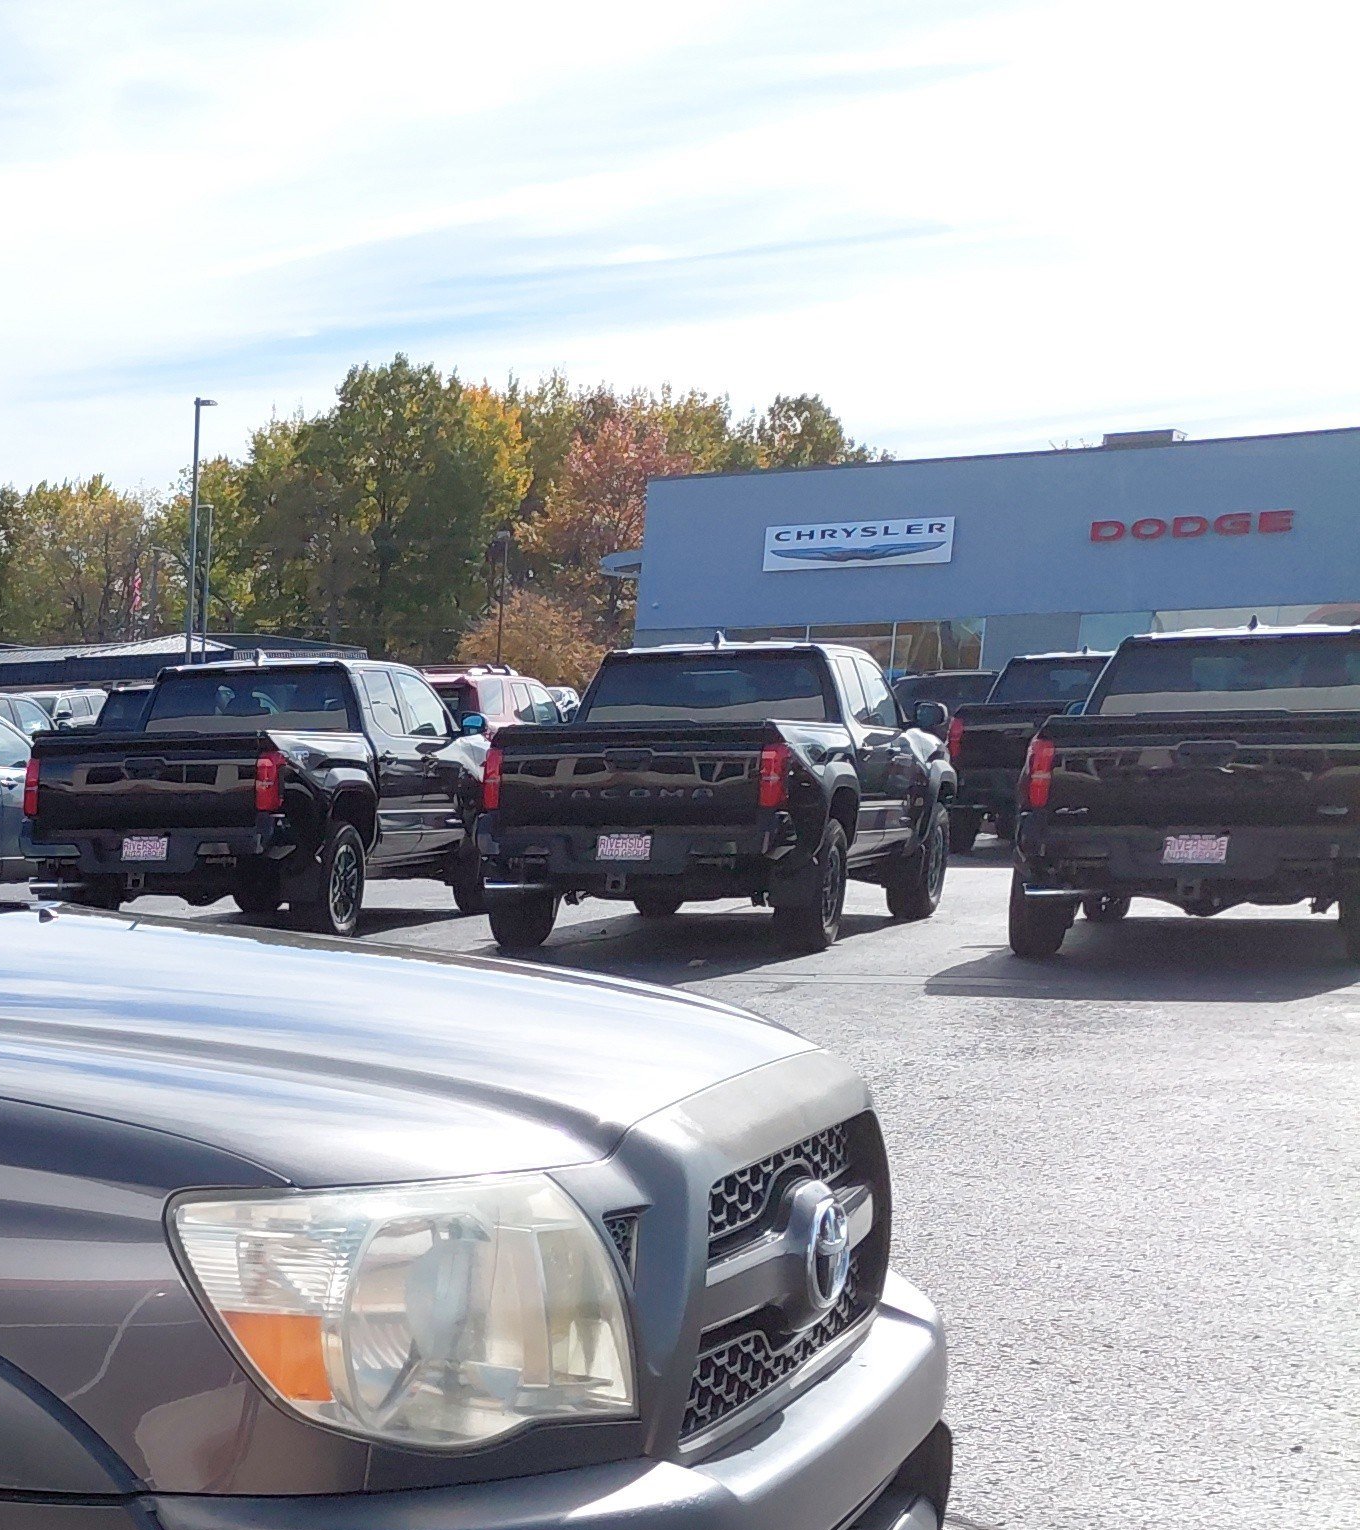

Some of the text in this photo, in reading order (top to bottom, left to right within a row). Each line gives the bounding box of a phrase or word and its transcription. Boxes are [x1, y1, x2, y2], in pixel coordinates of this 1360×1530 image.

[774, 522, 946, 542] CHRYSLER
[1090, 510, 1294, 542] DODGE
[600, 838, 650, 848] RIVERSIDE
[1165, 840, 1225, 850] RIVERSIDE
